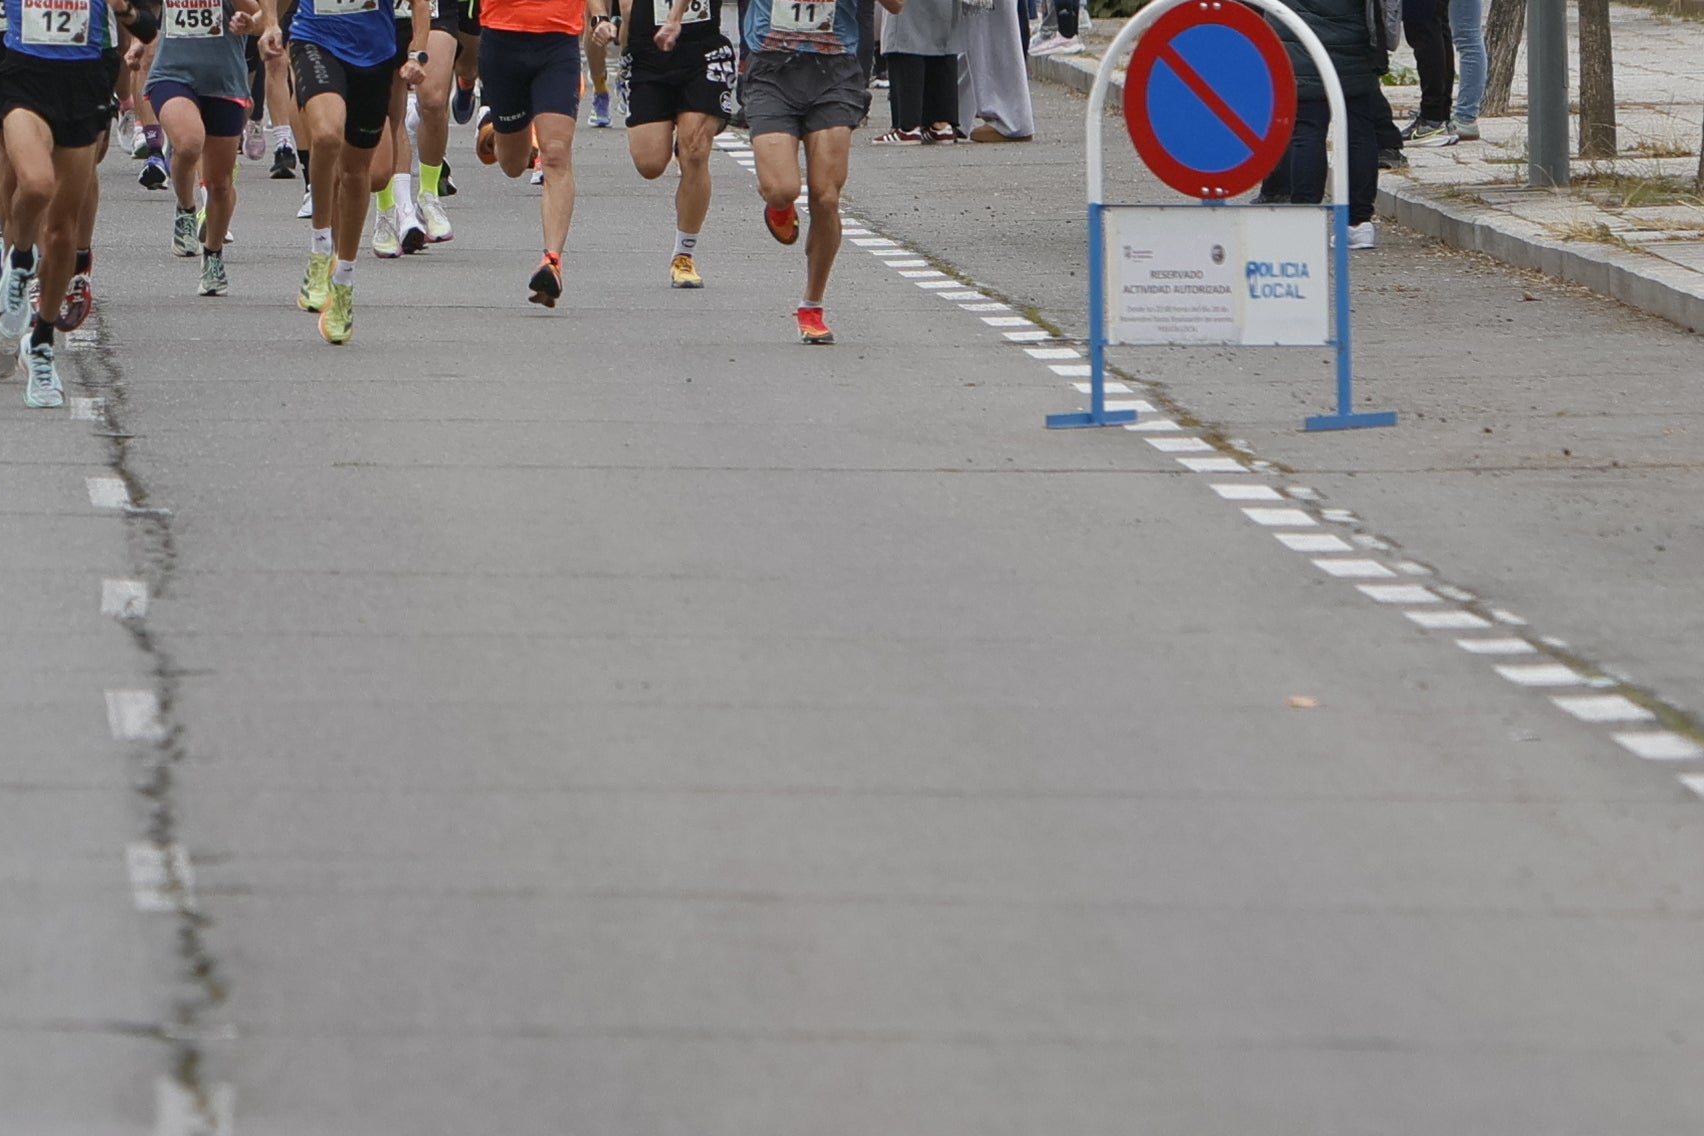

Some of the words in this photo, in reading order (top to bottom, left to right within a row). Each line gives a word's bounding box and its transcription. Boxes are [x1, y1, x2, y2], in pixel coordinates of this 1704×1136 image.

[42, 11, 71, 32] 12
[175, 9, 213, 28] 458
[791, 3, 815, 22] 11
[1245, 261, 1310, 279] POLICIA
[1249, 282, 1306, 300] LOCAL
